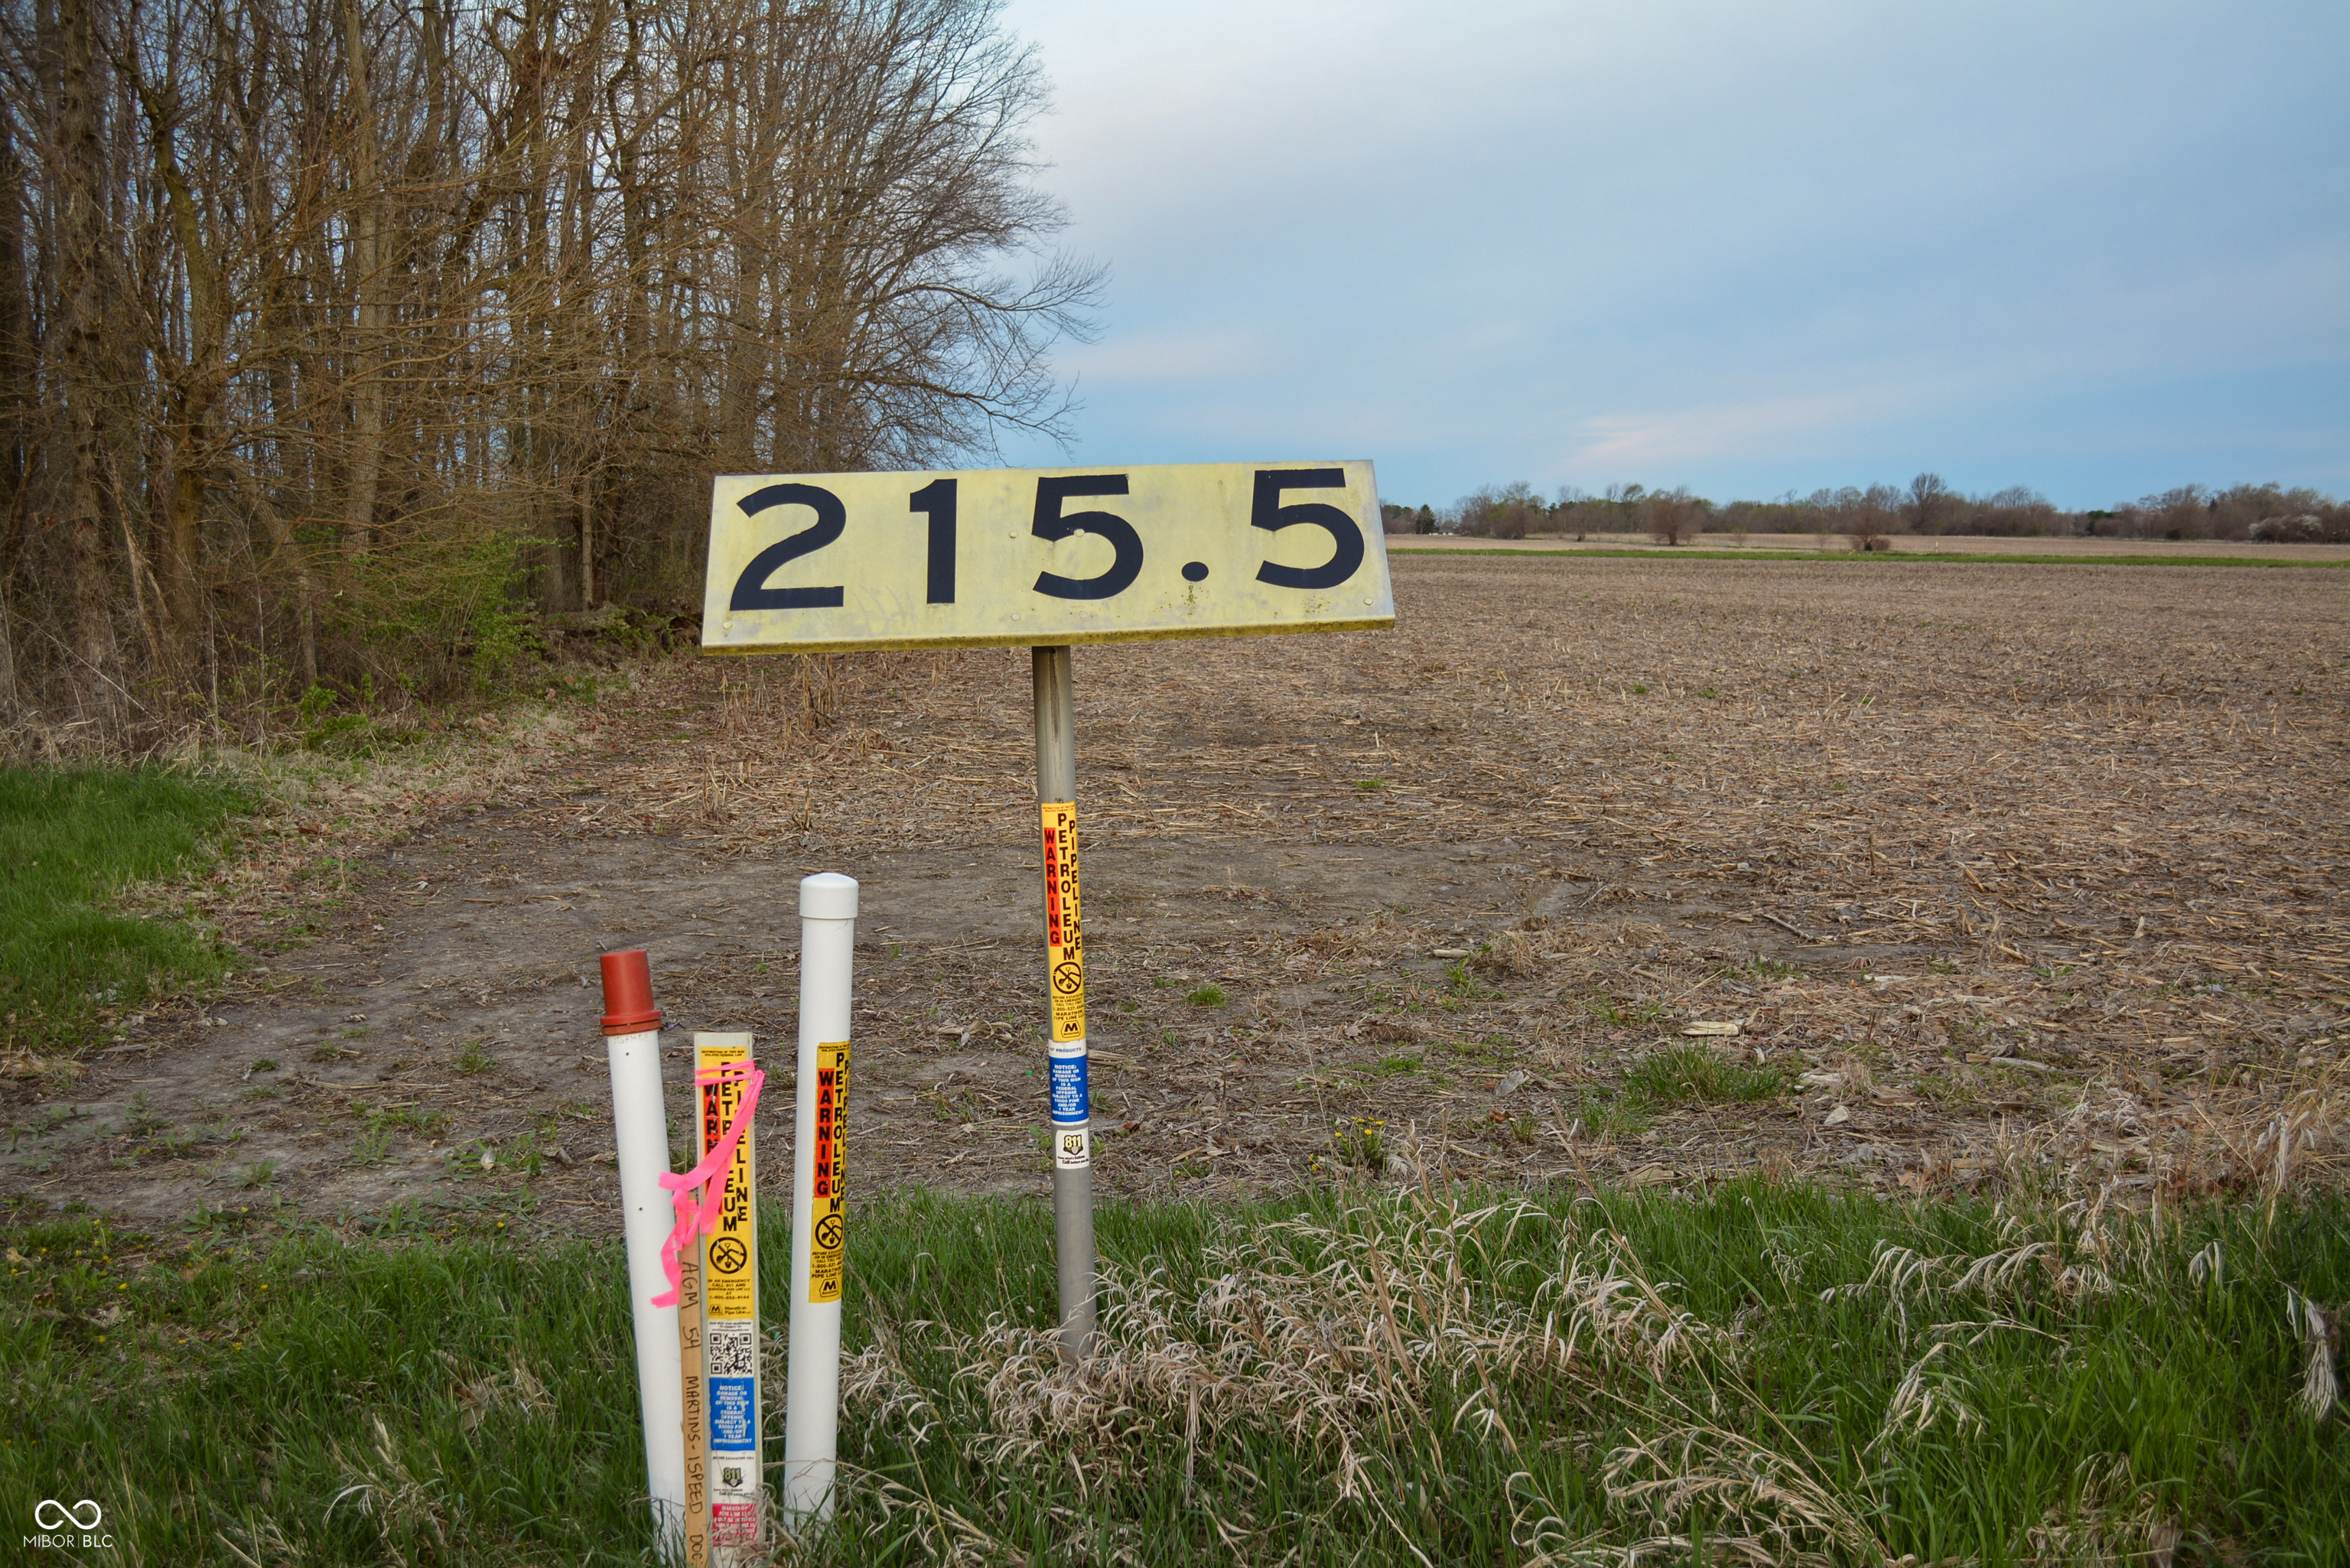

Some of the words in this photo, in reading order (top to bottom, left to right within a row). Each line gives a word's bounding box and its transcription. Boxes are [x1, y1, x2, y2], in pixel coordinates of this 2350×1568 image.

[729, 467, 1365, 611] 215.5
[1045, 829, 1060, 945] WARNING
[1057, 812, 1075, 961] PETROLEUM
[1069, 819, 1081, 951] PIPELINE
[817, 1071, 834, 1196] WARNING
[830, 1052, 844, 1213] PETROLEUM
[1064, 1134, 1082, 1148] 811
[682, 1261, 699, 1309] AGM
[683, 1326, 701, 1350] 54
[724, 1467, 742, 1480] 811
